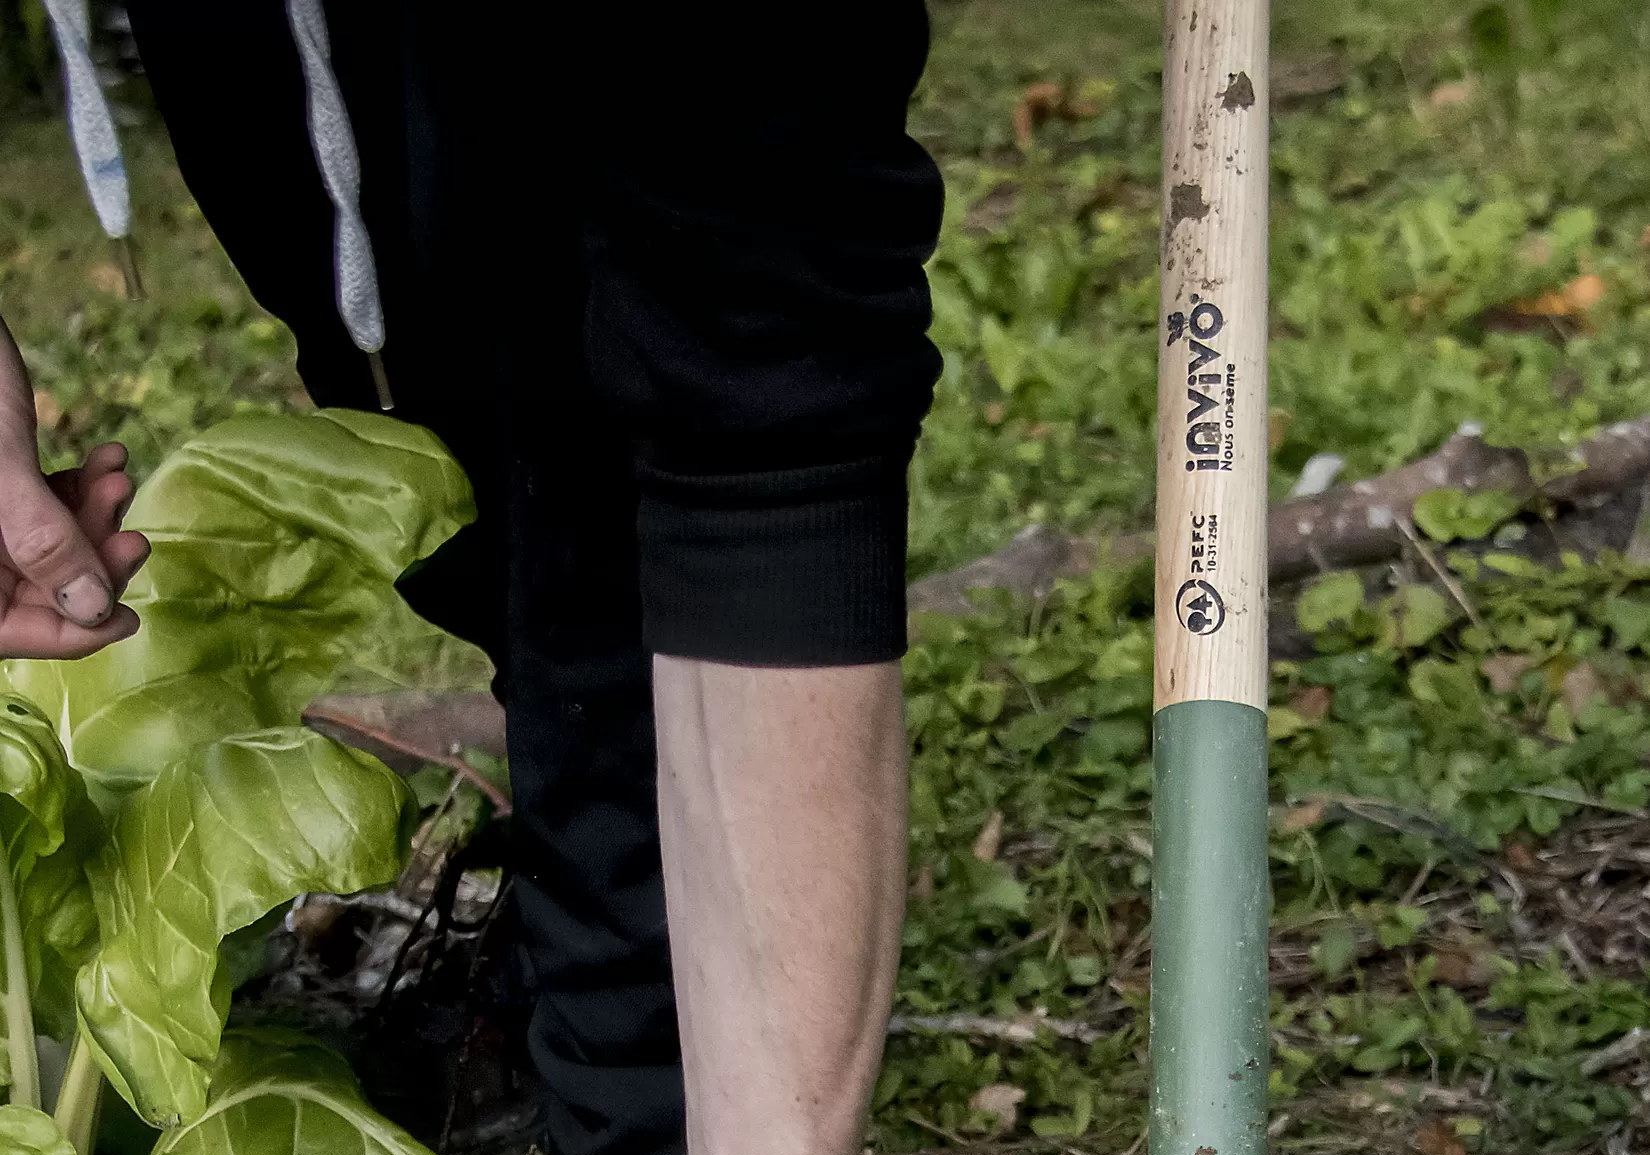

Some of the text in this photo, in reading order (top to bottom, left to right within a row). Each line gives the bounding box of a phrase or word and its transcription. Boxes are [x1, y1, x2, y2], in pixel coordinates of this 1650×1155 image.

[1221, 364, 1236, 406] sème
[1220, 433, 1234, 471] Nous
[1191, 515, 1205, 574] PEFC
